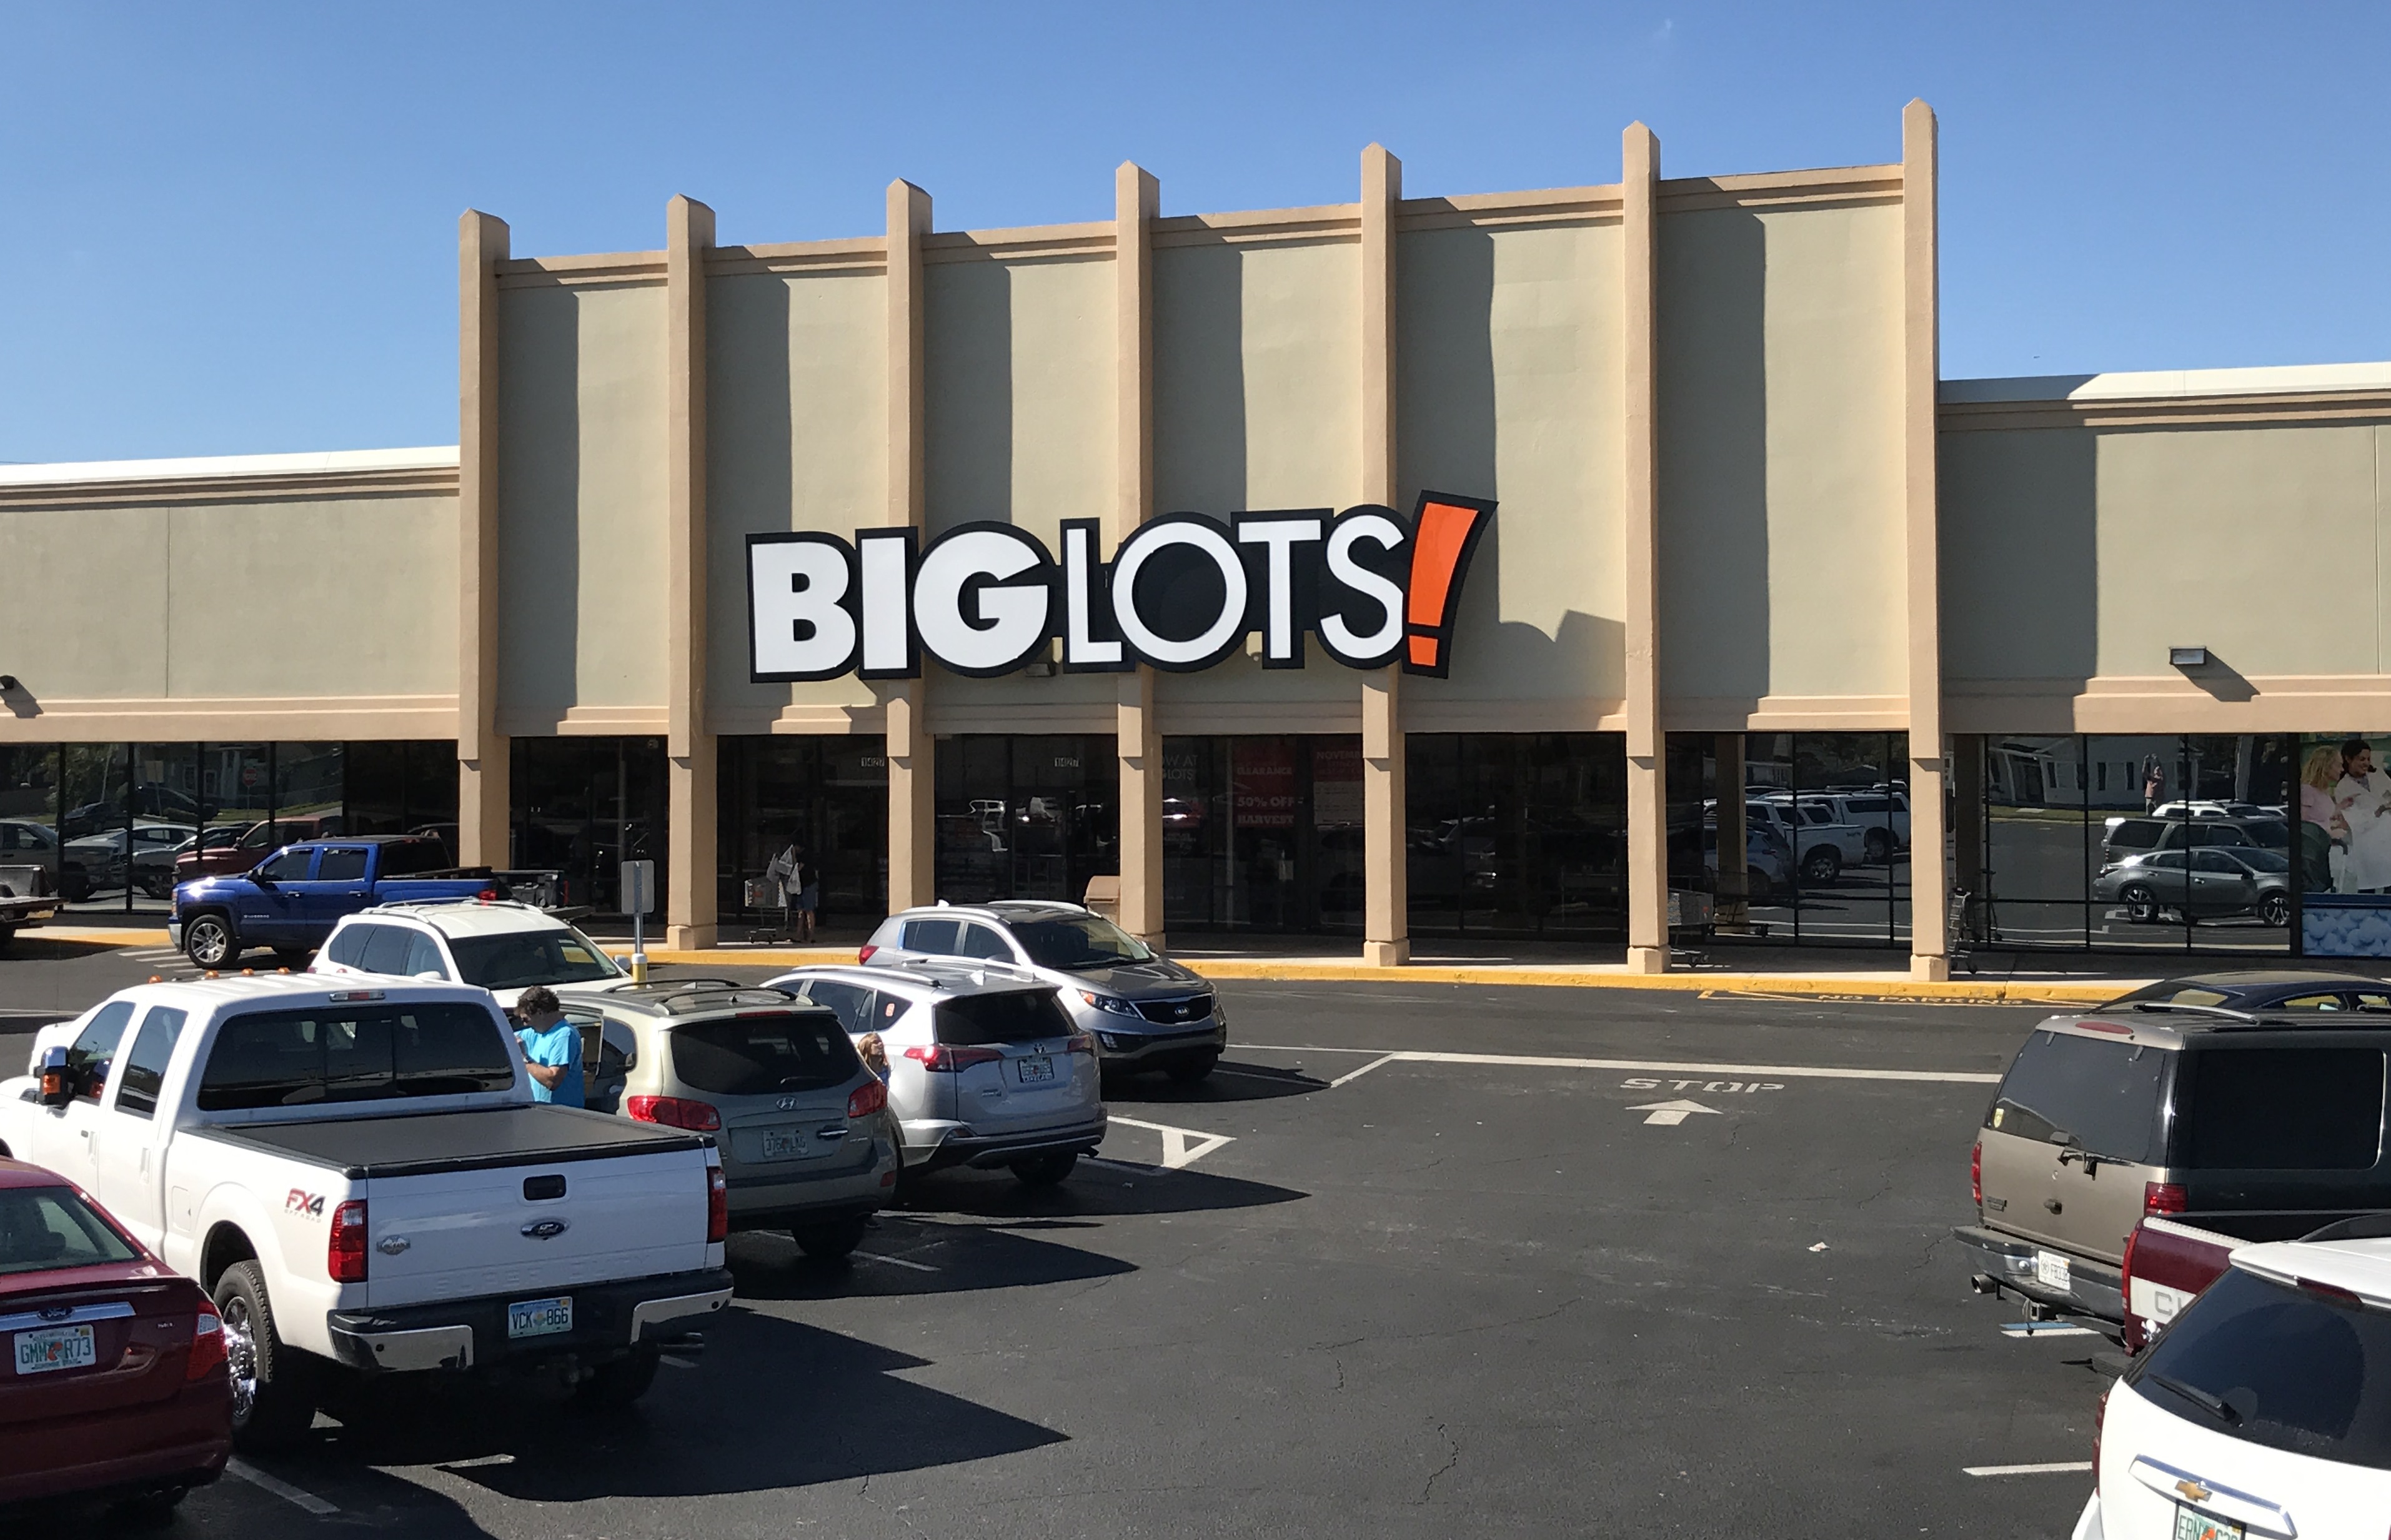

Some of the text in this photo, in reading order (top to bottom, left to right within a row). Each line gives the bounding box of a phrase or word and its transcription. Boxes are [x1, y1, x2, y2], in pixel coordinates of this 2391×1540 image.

[1237, 797, 1295, 808] 50% OFF
[1237, 815, 1295, 825] HARVEST
[1620, 1078, 1785, 1093] STOP
[286, 1188, 326, 1216] FX4
[512, 1308, 568, 1329] VCK 866
[64, 1337, 91, 1359] R73
